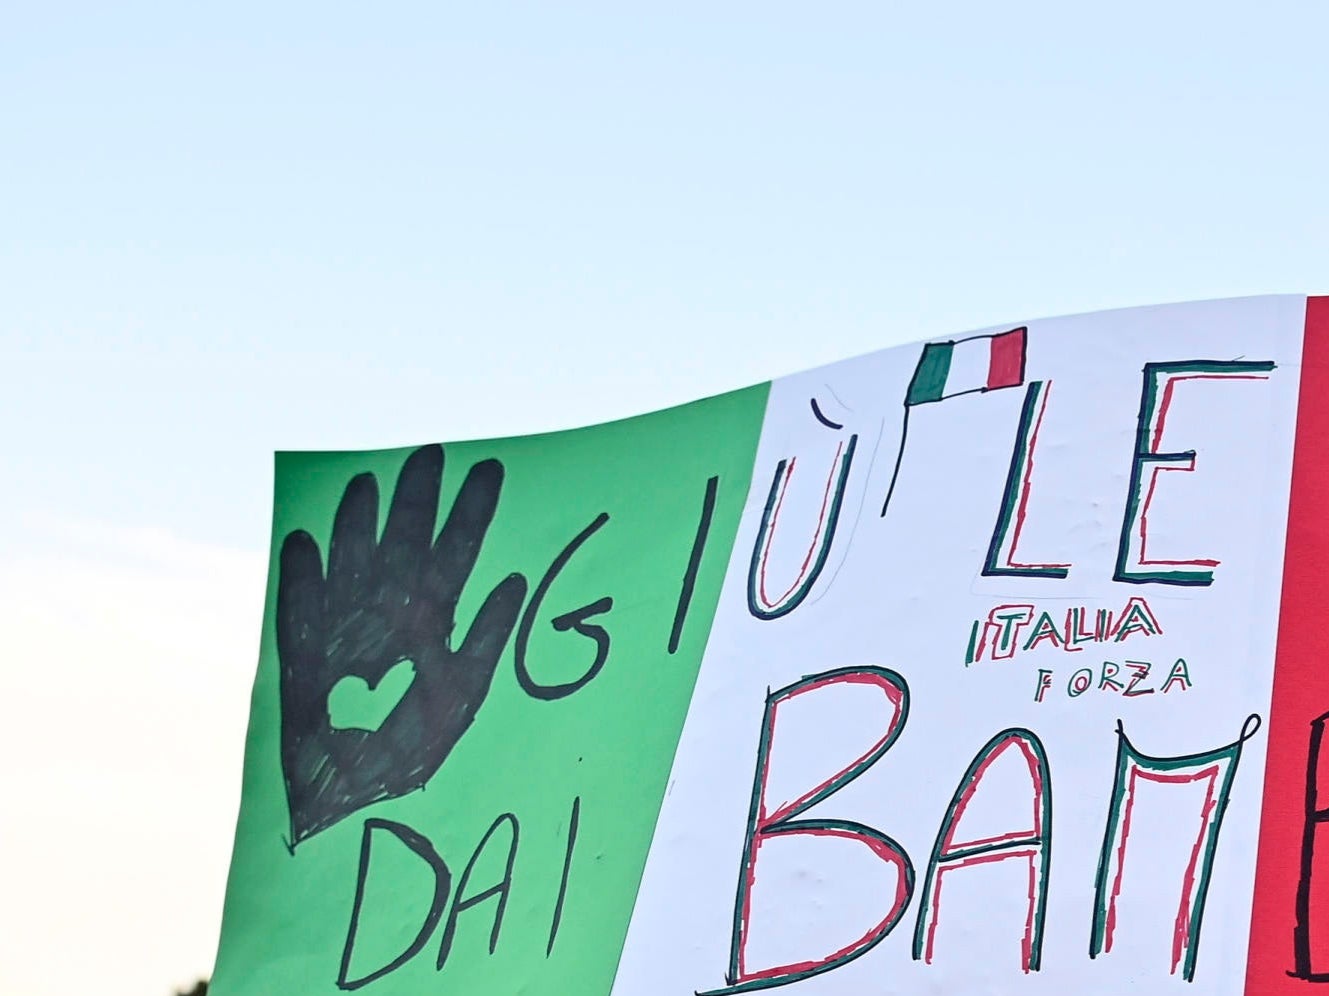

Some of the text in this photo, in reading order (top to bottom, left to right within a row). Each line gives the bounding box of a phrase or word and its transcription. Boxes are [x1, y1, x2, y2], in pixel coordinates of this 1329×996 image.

[514, 397, 858, 701] GIÙ
[981, 359, 1278, 588] LE
[965, 597, 1163, 667] ITALIA
[1034, 658, 1193, 702] FORZA
[337, 796, 581, 991] DAI
